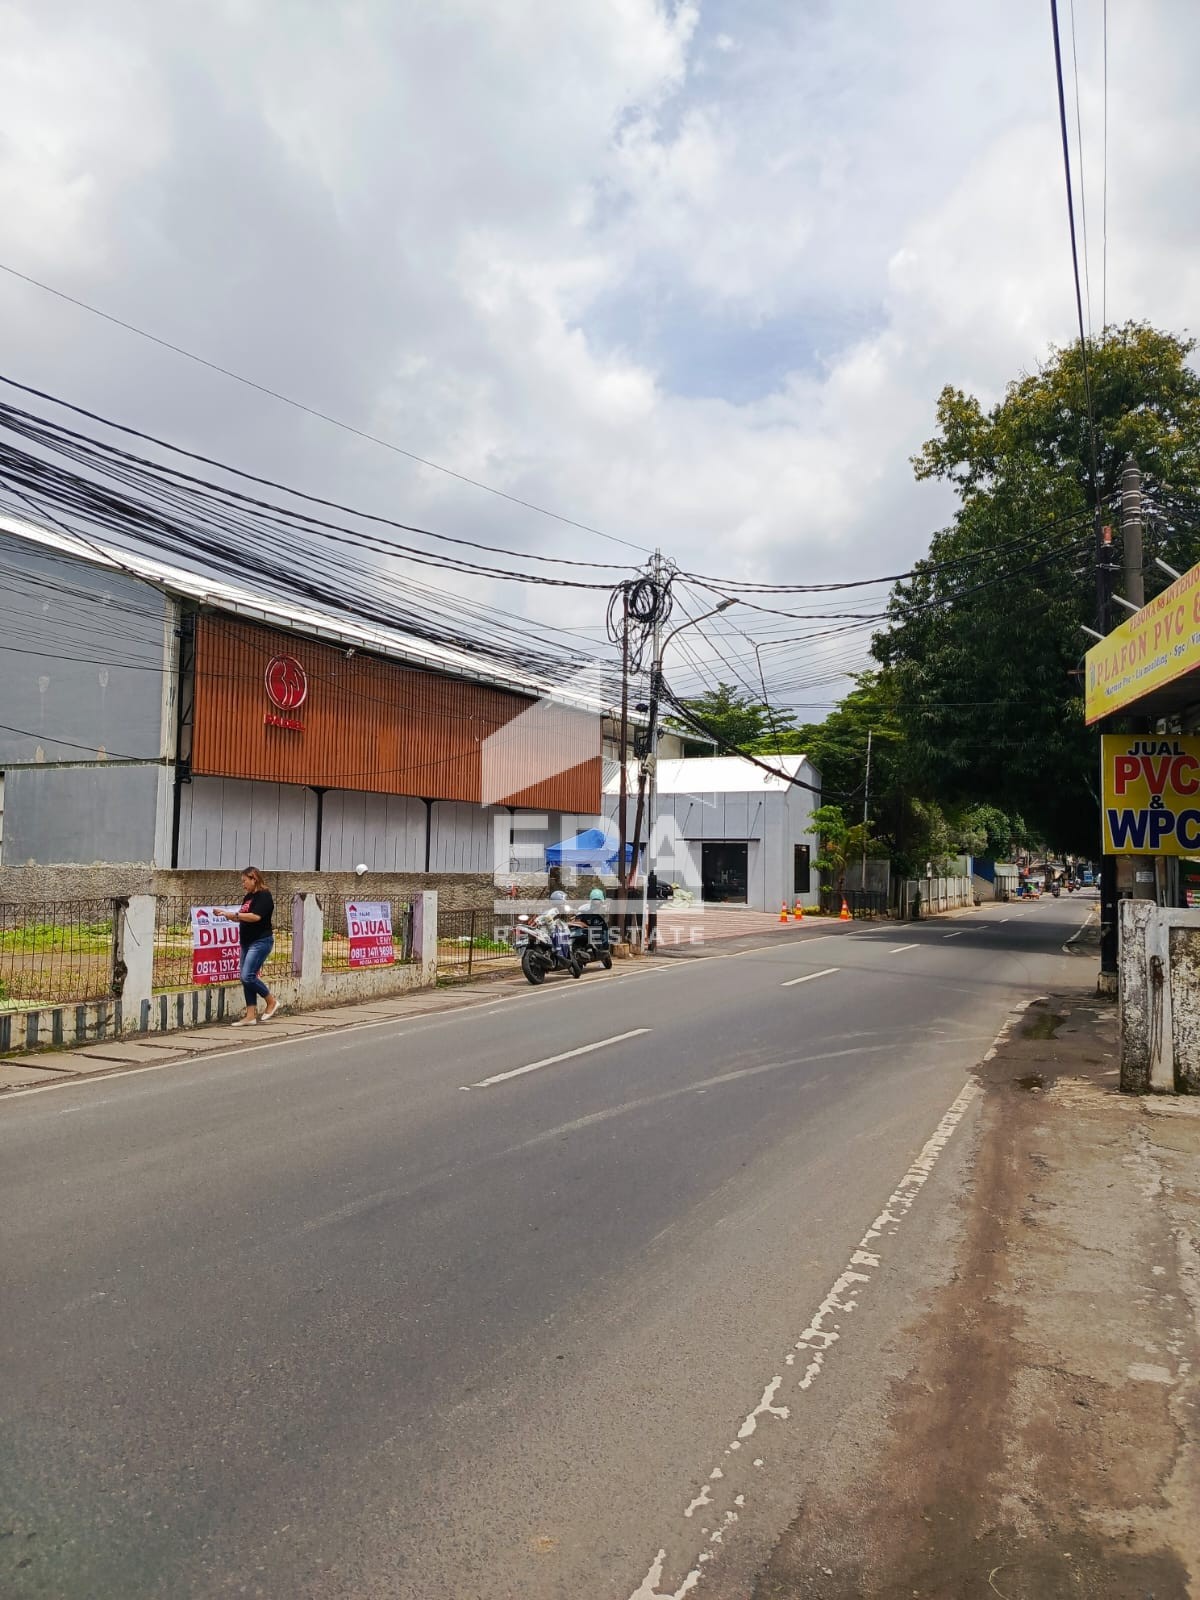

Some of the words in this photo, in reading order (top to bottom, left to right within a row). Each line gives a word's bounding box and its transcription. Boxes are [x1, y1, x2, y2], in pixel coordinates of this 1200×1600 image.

[1097, 631, 1147, 686] PLAFON
[1153, 604, 1185, 650] PVC
[1128, 742, 1185, 756] JUAL
[1115, 756, 1200, 795] PVC
[1149, 795, 1164, 810] &
[1107, 809, 1200, 849] WPC
[352, 920, 390, 936] DIJUAL
[200, 927, 239, 946] DIJU
[222, 948, 240, 957] SAN
[197, 961, 217, 974] 0812
[219, 960, 235, 972] 1312
